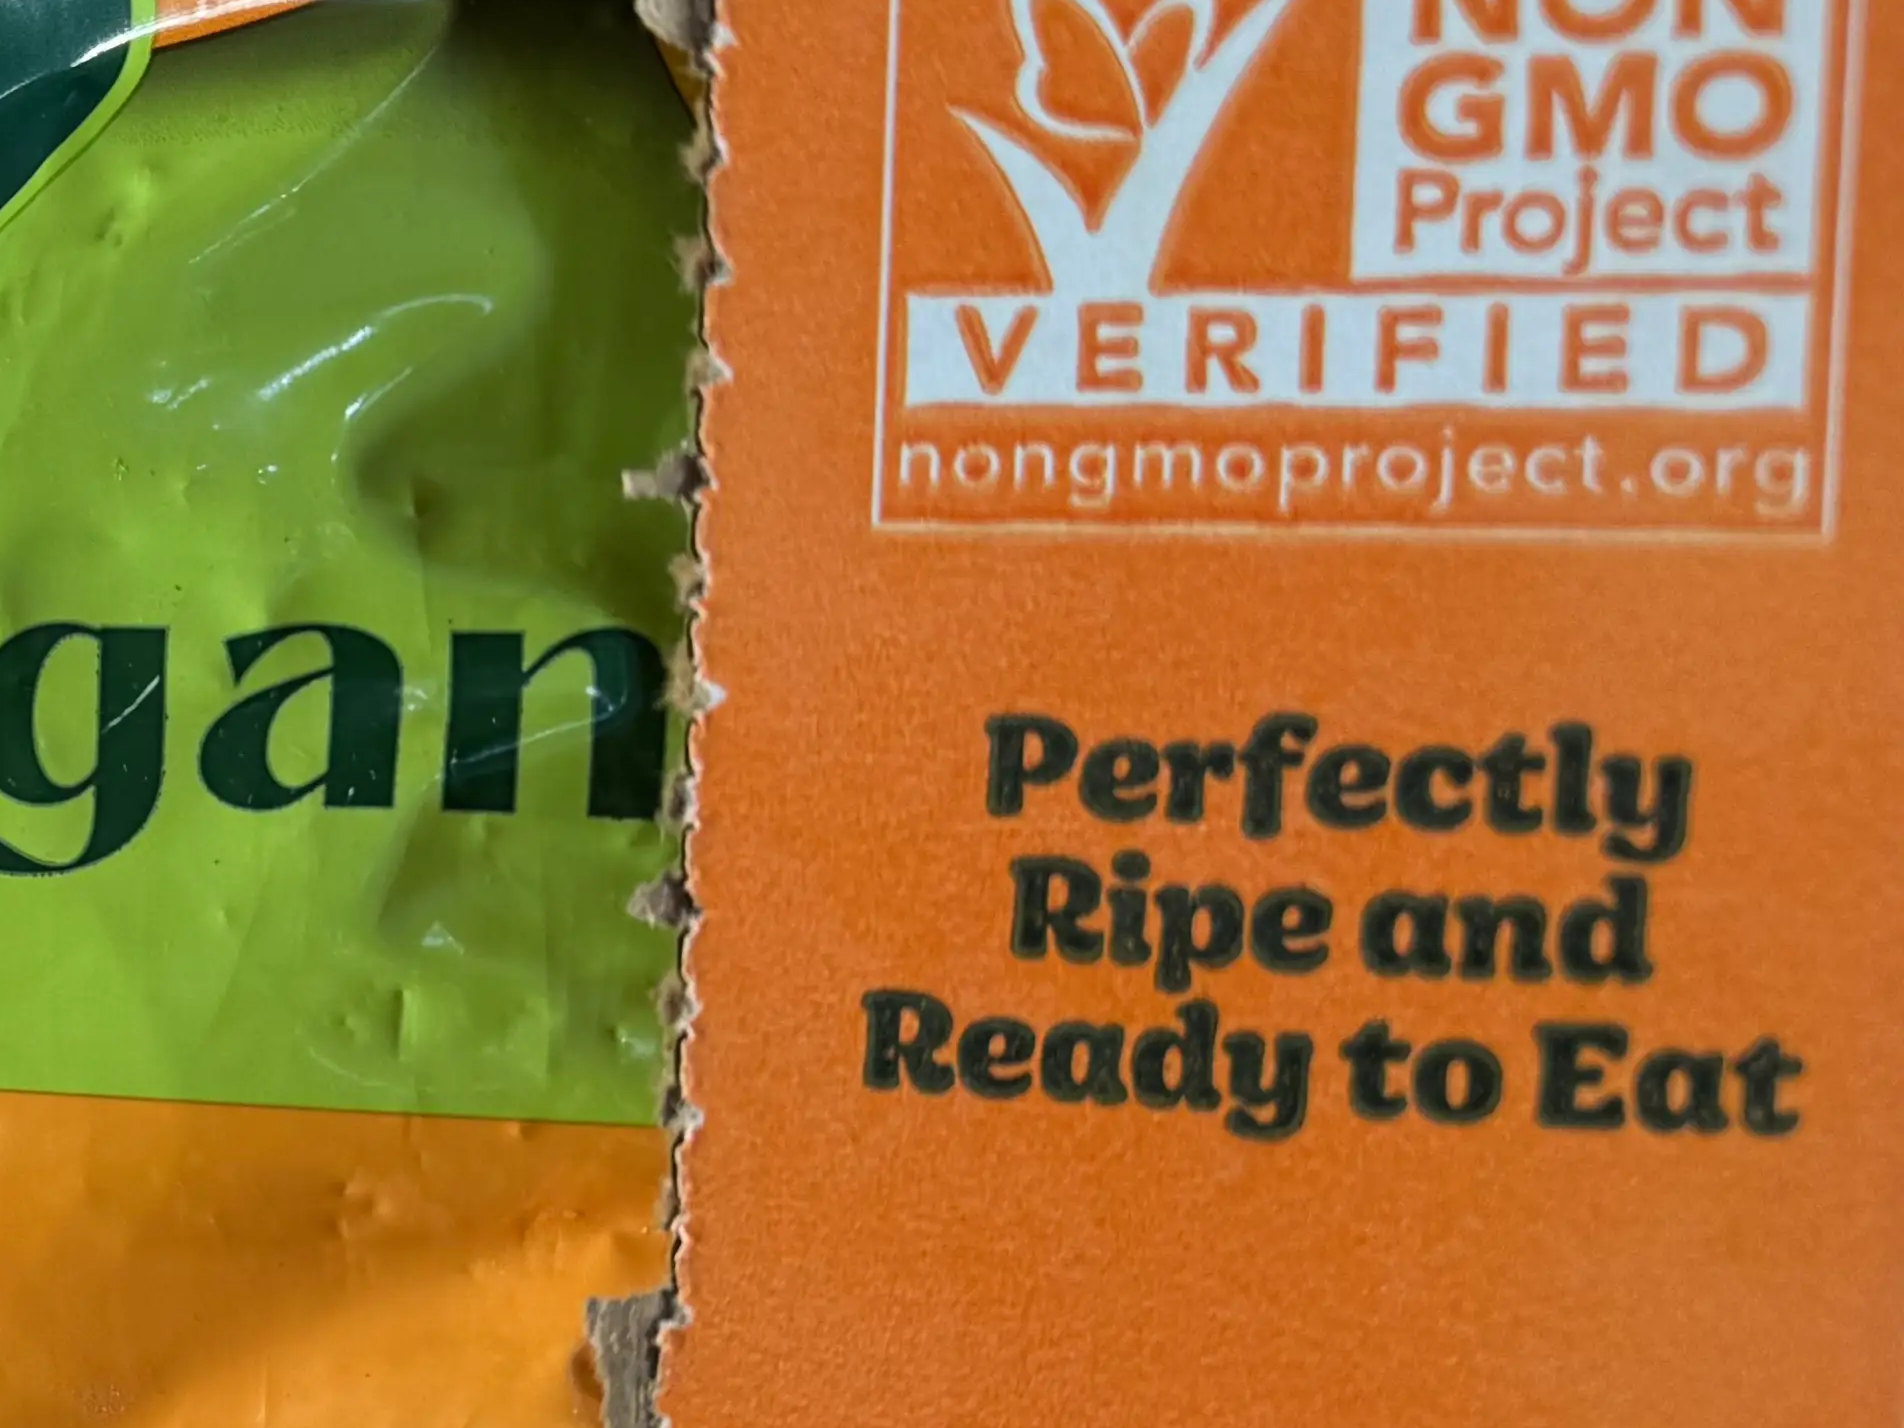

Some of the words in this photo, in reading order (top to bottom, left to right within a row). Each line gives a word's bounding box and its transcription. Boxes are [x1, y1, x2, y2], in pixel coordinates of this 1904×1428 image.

[1398, 51, 1790, 160] GMO
[1395, 169, 1783, 273] Project
[955, 302, 1769, 392] VERIFIED
[898, 427, 1807, 511] nongmoproject.org
[984, 712, 1693, 862] Perfectly
[1010, 849, 1332, 991] Ripe
[1361, 874, 1653, 983] and
[862, 989, 1313, 1139] Ready
[1341, 1016, 1502, 1124] to
[1532, 1021, 1802, 1135] Eat
